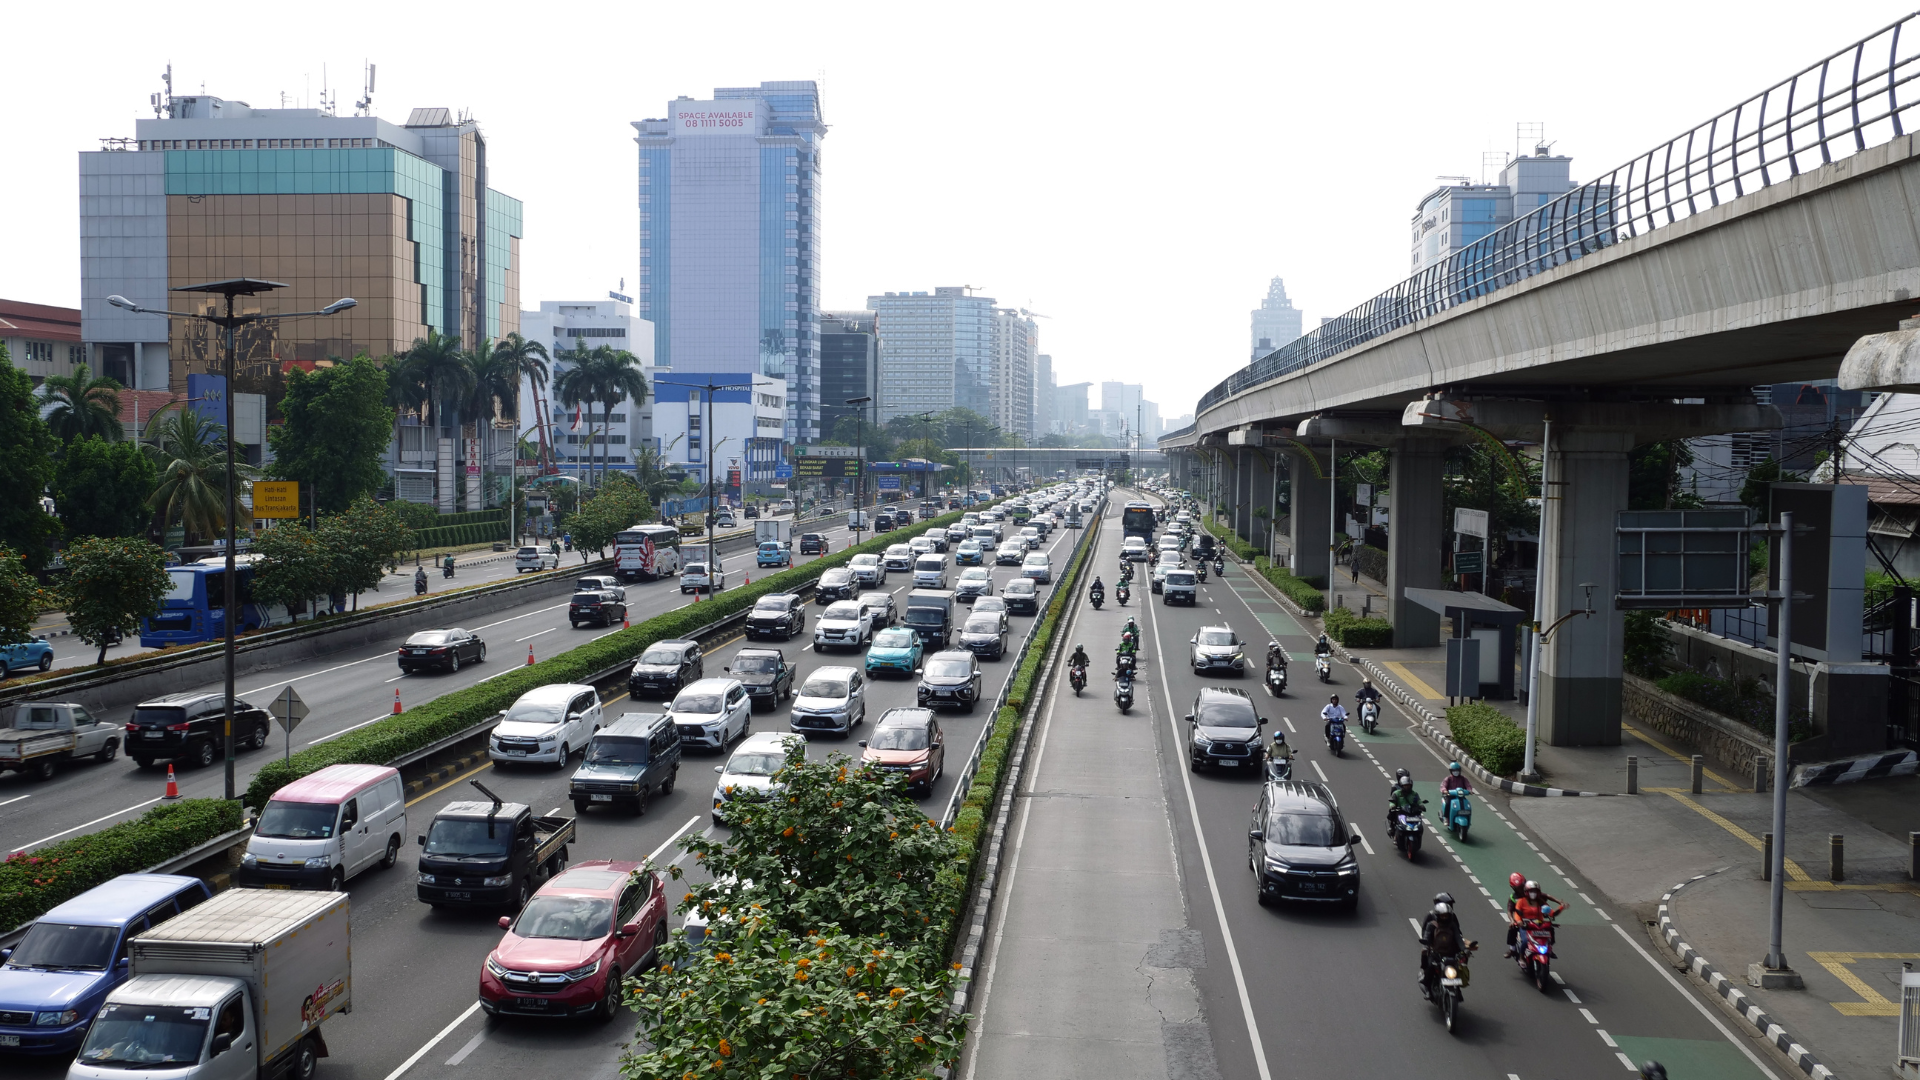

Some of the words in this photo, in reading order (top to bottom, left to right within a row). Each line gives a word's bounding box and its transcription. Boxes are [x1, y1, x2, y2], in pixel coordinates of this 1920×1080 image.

[678, 112, 706, 120] SPACE
[708, 111, 753, 119] AVAILABLE
[685, 119, 698, 128] 08
[700, 119, 716, 127] 1111
[719, 118, 744, 127] 5005
[254, 504, 265, 512] Bus
[265, 504, 297, 513] Transjakarta
[516, 997, 521, 1005] B
[523, 997, 535, 1005] 1317
